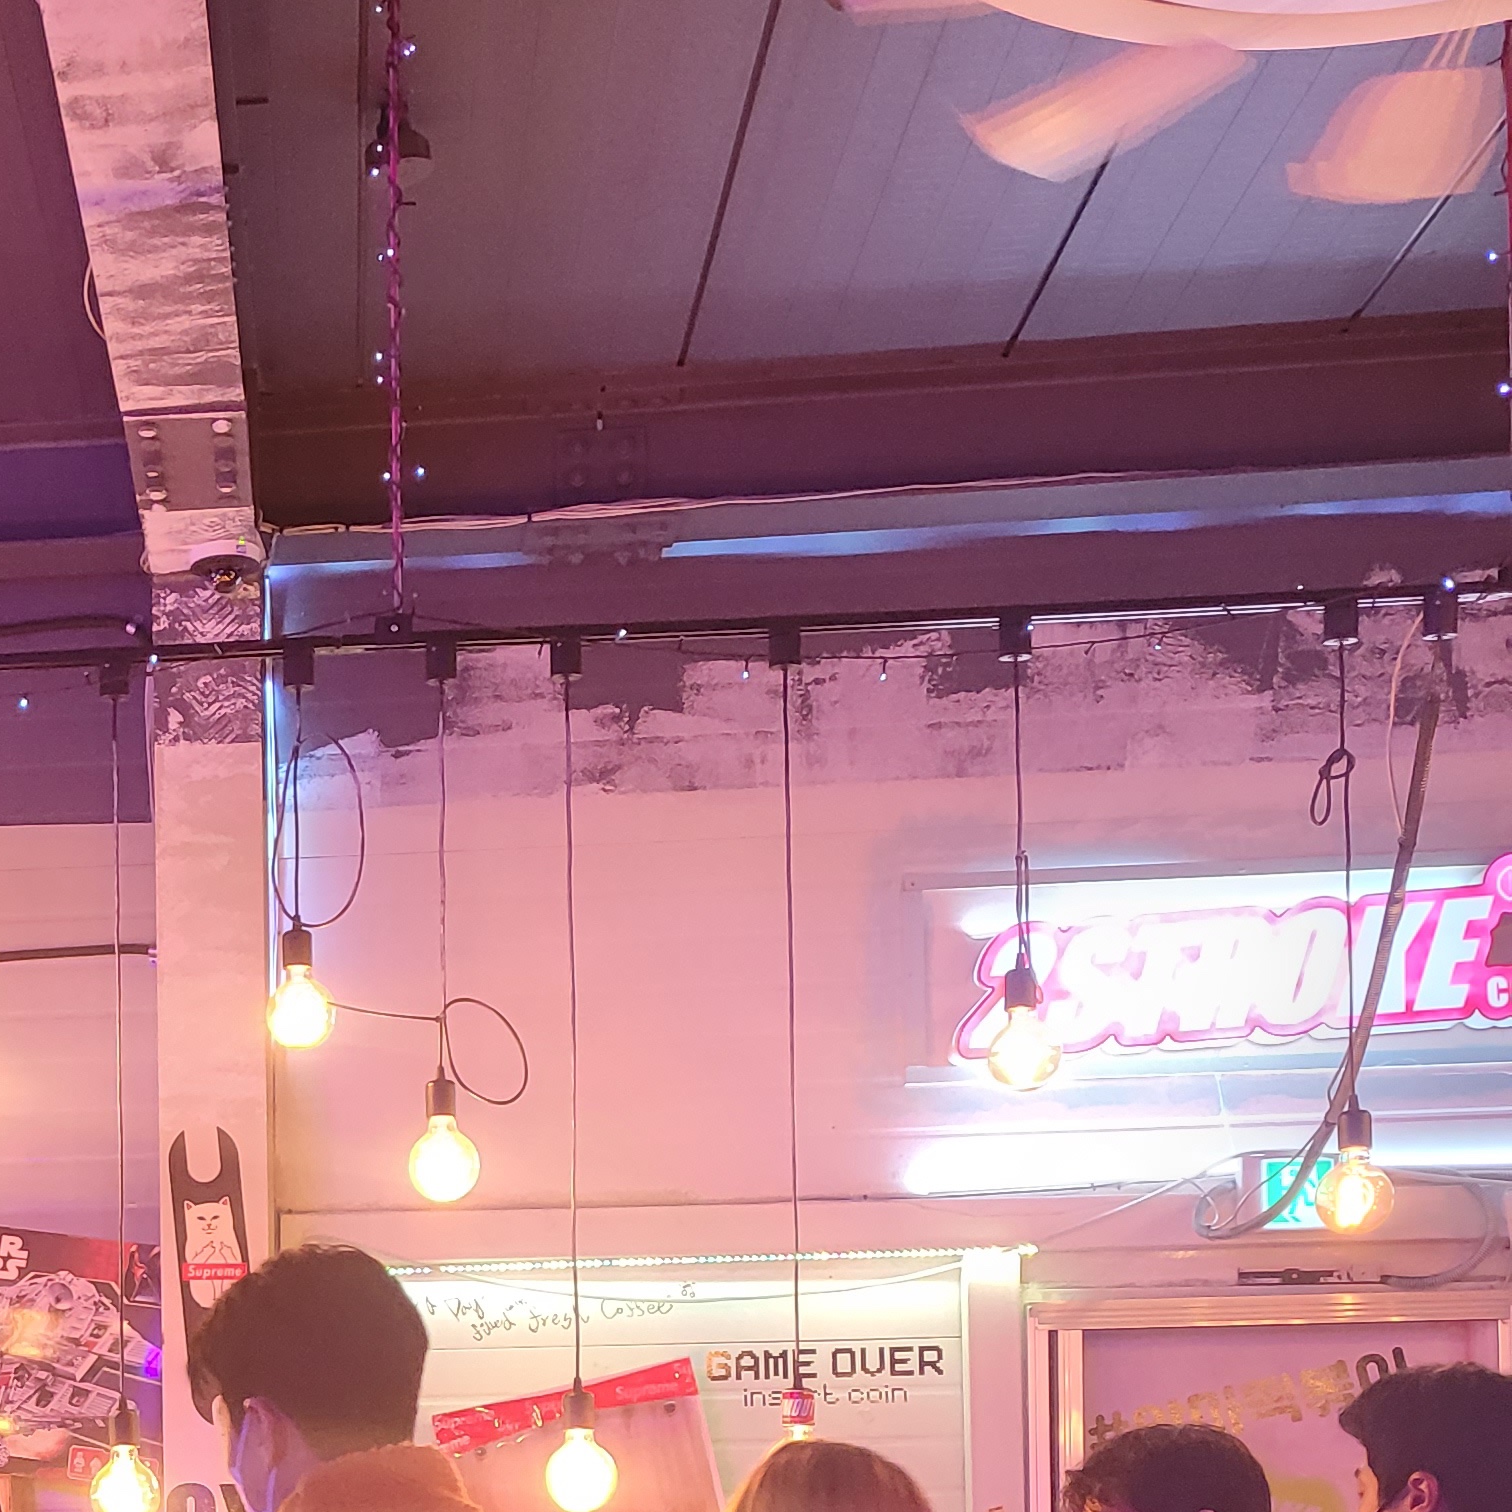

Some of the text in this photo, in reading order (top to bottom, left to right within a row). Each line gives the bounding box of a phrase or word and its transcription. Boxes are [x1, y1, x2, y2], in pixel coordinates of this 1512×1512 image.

[187, 1265, 243, 1279] Supreme
[706, 1348, 818, 1381] GAME
[831, 1345, 944, 1378] OVER
[848, 1384, 908, 1405] coin
